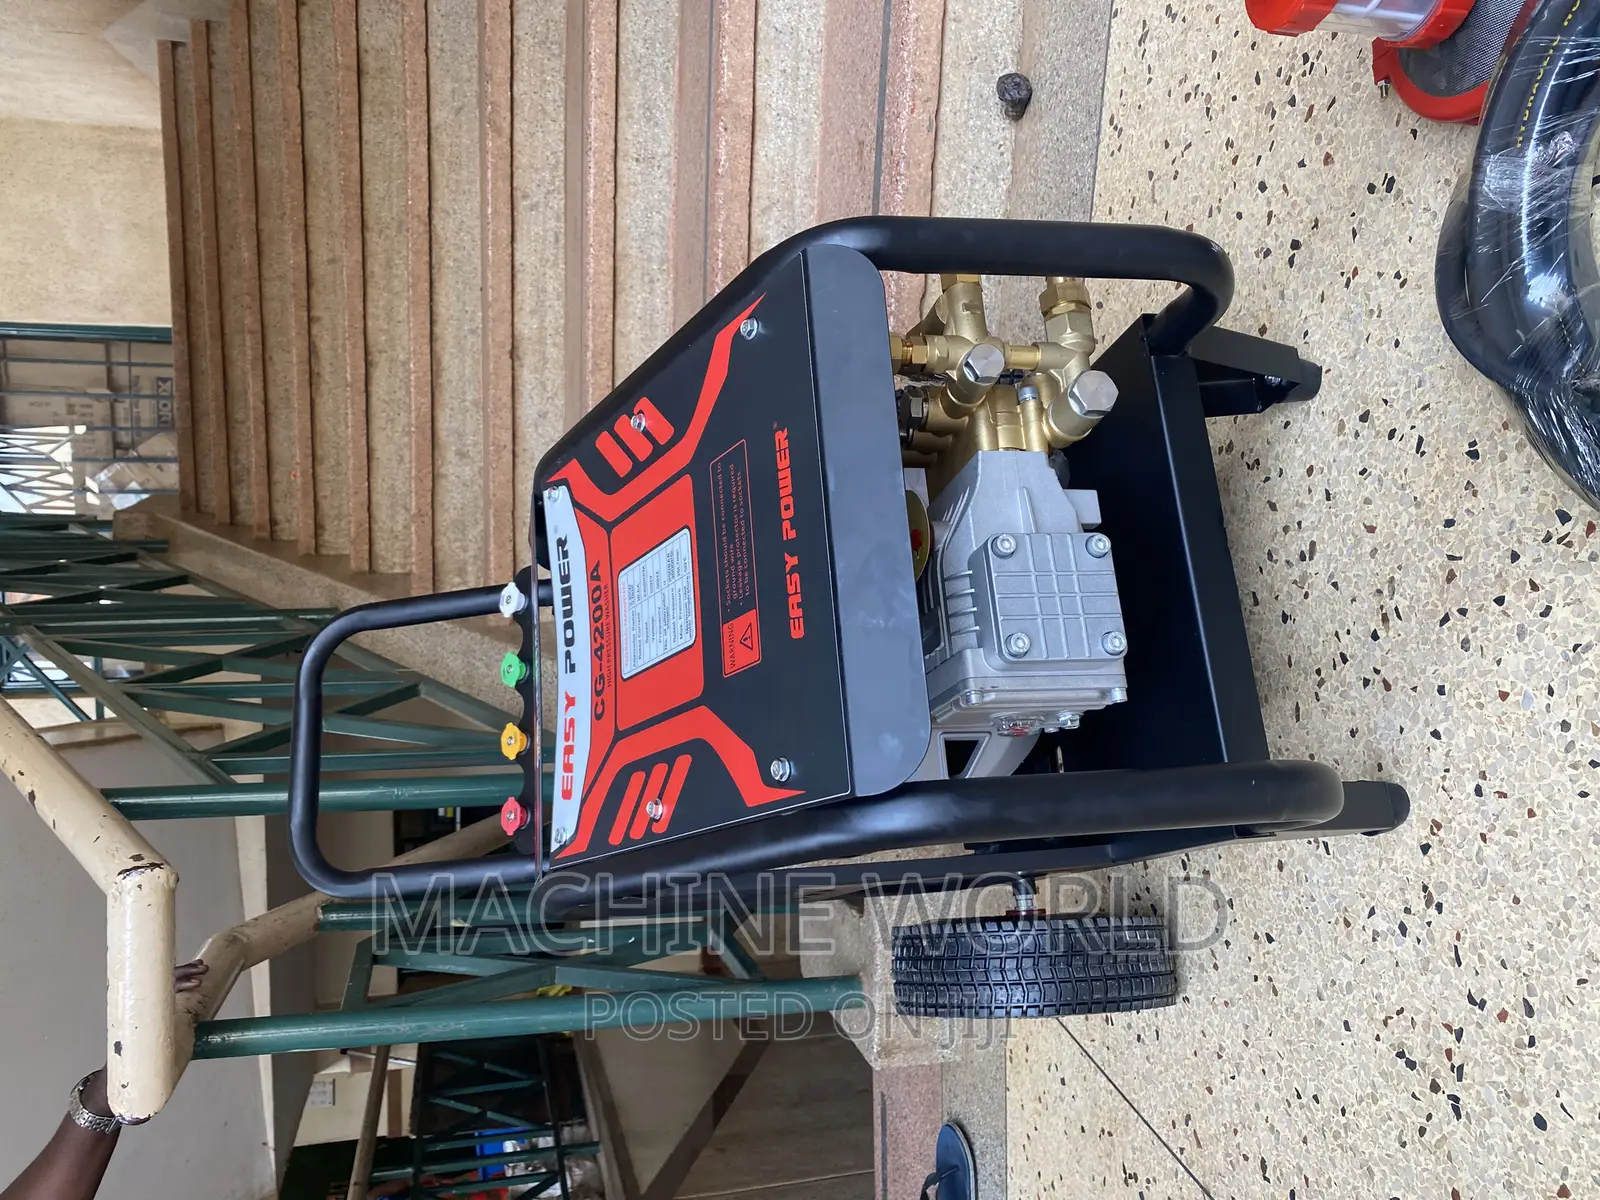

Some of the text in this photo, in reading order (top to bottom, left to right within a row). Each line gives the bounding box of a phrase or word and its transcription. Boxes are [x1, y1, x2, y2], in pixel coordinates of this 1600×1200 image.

[716, 463, 722, 475] to
[717, 476, 726, 521] connected
[721, 522, 727, 536] be
[728, 463, 744, 599] Leakage protector is required
[736, 471, 750, 596] to be connected to sockets
[774, 428, 805, 639] EASY POWER
[730, 563, 738, 600] ground
[556, 534, 576, 800] EASY POWER
[591, 560, 606, 721] CG-4200A
[727, 623, 737, 670] WARNING
